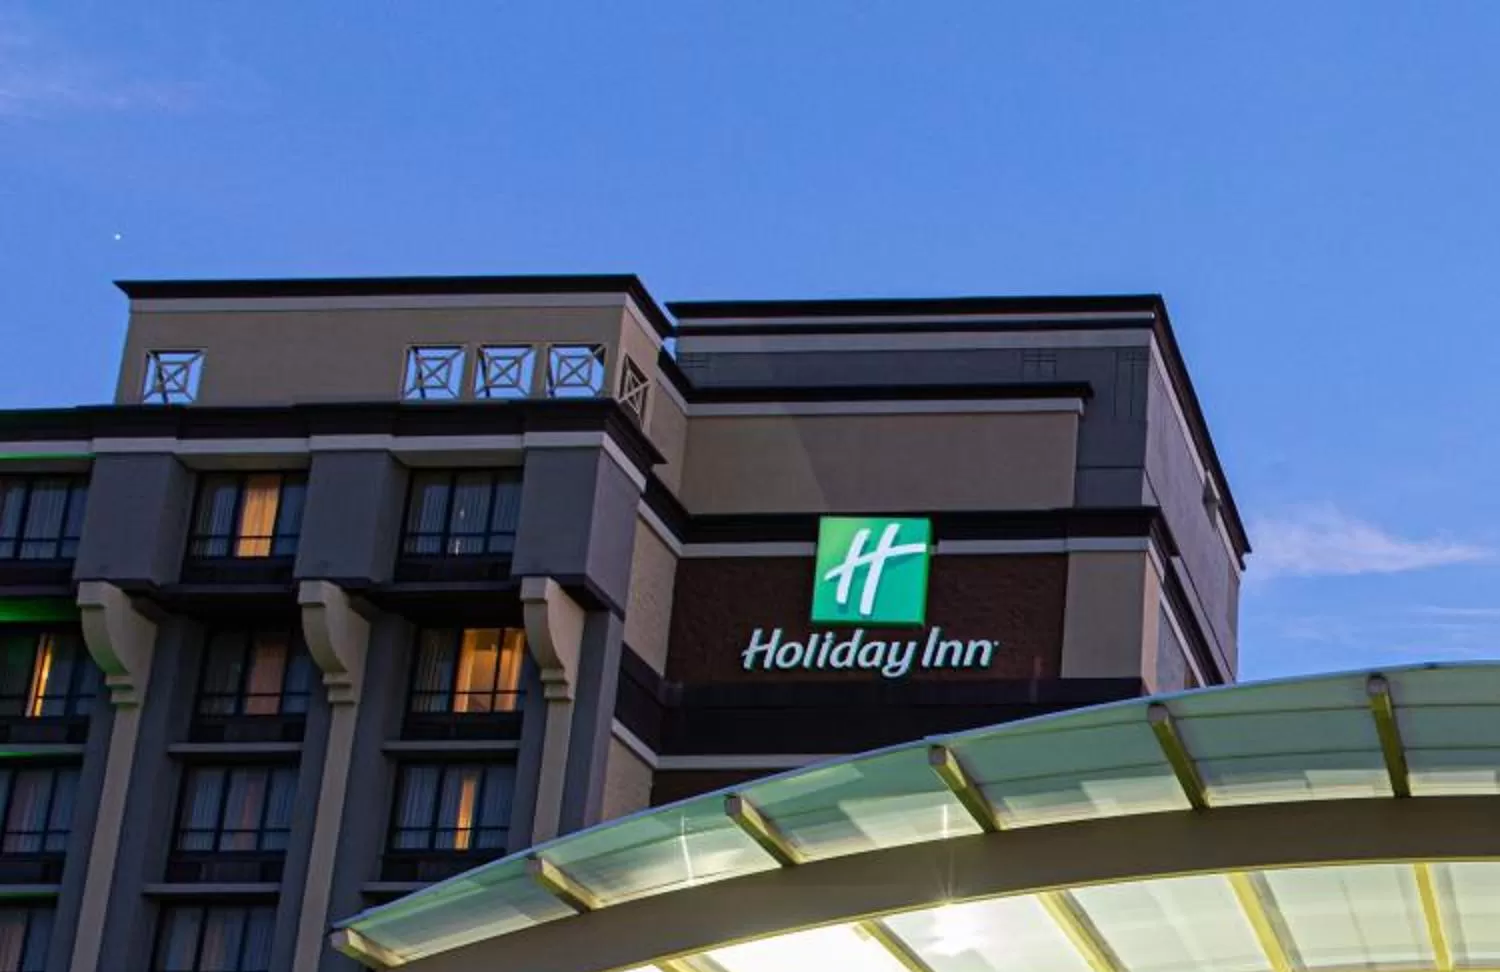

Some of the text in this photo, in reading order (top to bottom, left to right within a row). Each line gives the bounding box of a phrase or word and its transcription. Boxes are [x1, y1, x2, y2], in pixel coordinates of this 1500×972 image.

[824, 523, 926, 616] H
[741, 626, 994, 678] Holiday Inn
